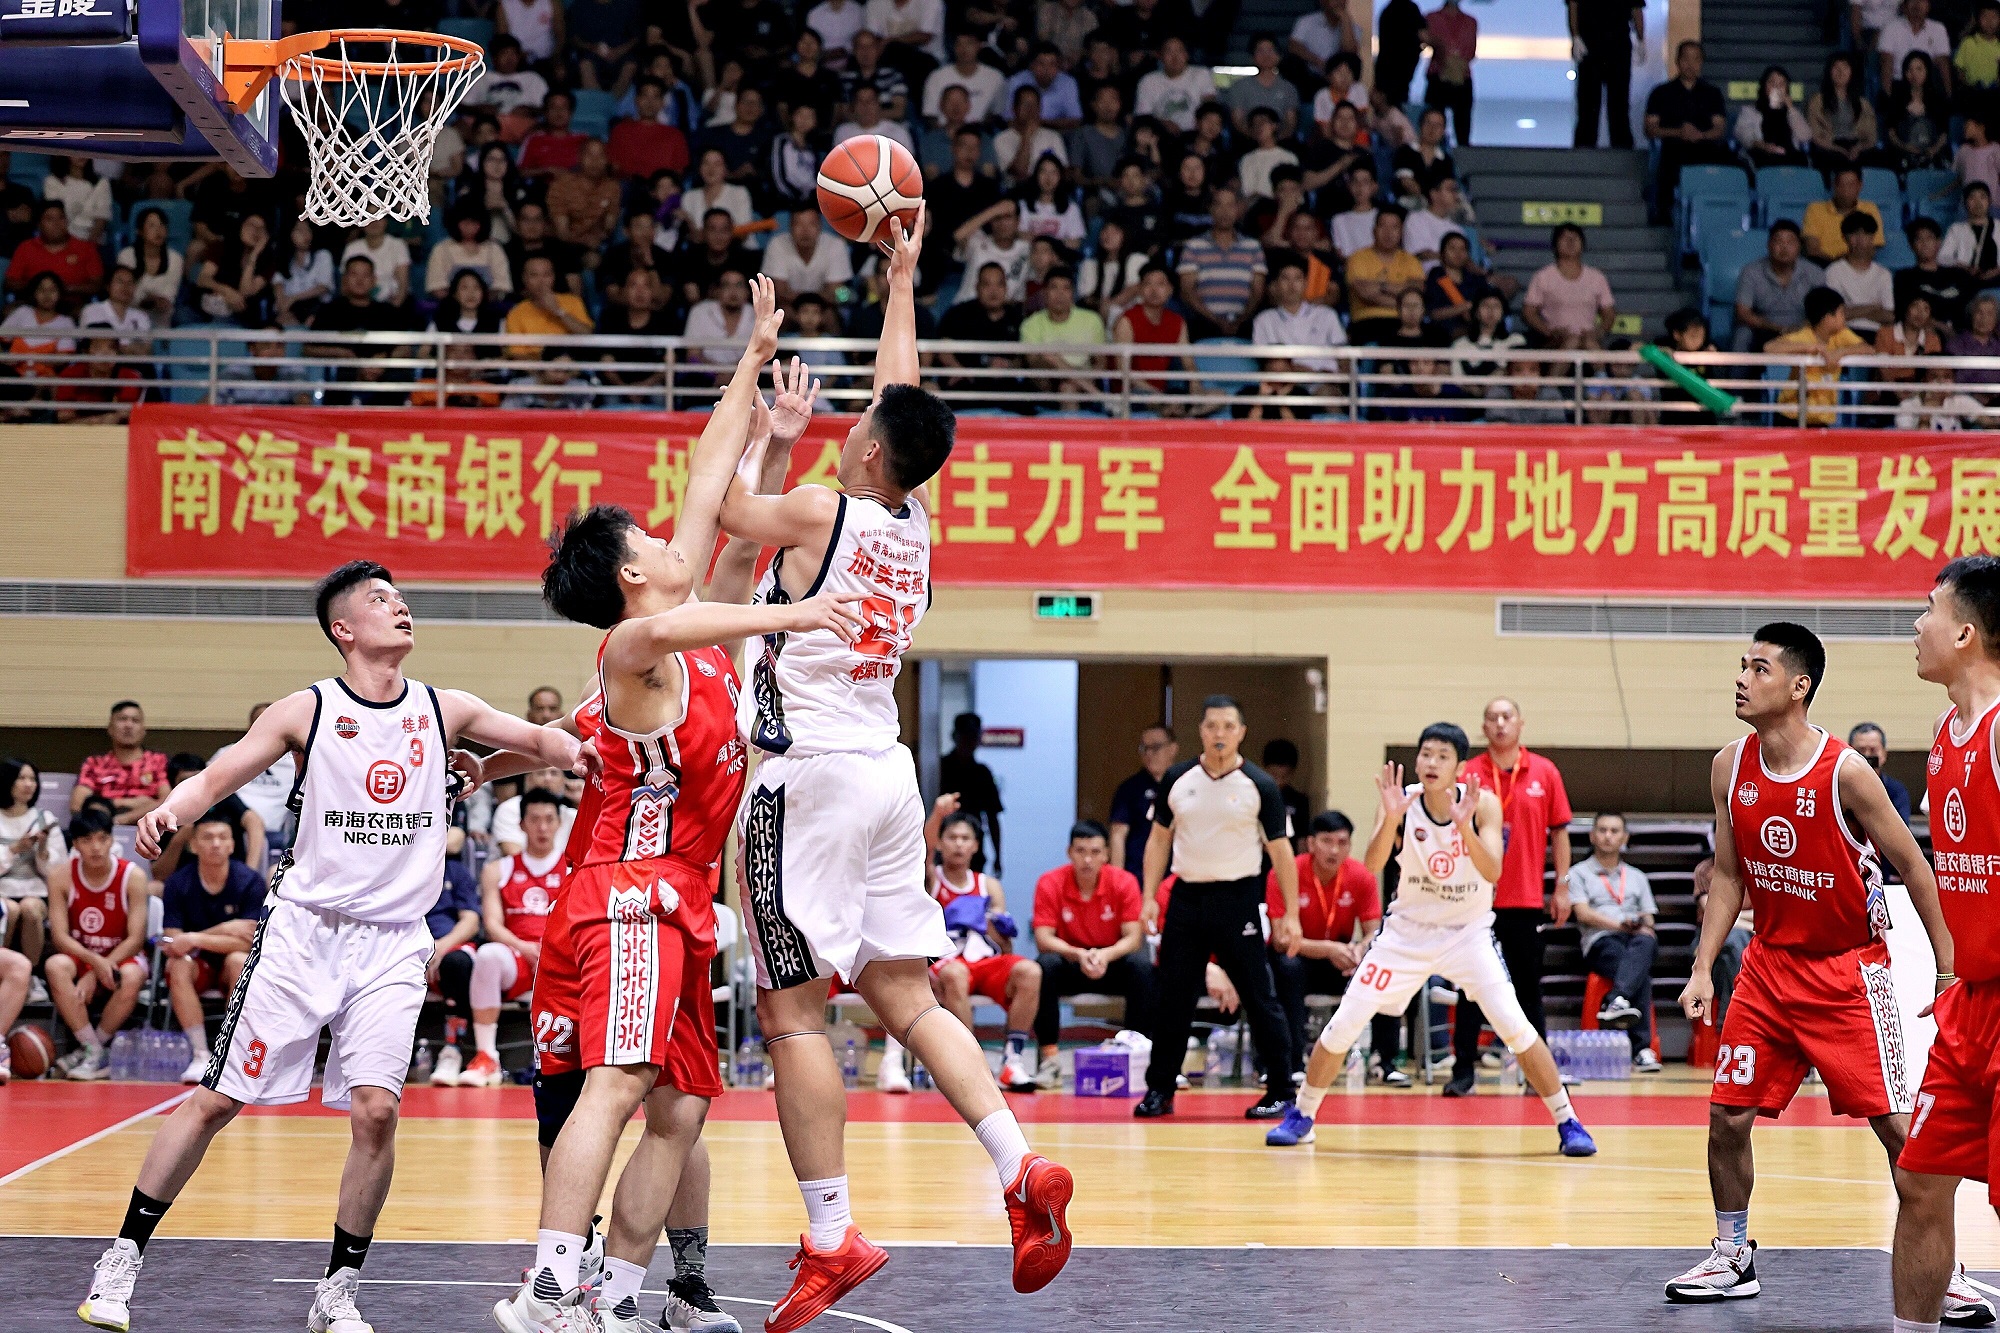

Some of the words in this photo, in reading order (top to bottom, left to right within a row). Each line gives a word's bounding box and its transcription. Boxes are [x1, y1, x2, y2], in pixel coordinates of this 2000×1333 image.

[157, 429, 602, 540] 南海农商银行
[1211, 445, 2000, 560] 全面助力地方高质量发展
[409, 737, 425, 768] 3
[324, 810, 433, 830] 南海农商银行
[1796, 798, 1816, 818] 23
[343, 831, 379, 845] NRC
[1934, 851, 2000, 876] 海农商银行
[1755, 877, 1782, 892] NRC
[1783, 881, 1818, 901] BANK
[1938, 875, 1957, 891] NRC
[1958, 876, 1989, 894] BANK
[1361, 962, 1393, 991] 30
[536, 1010, 574, 1054] 22
[242, 1039, 268, 1079] 3
[1714, 1044, 1756, 1086] 23
[1909, 1091, 1936, 1139] 7
